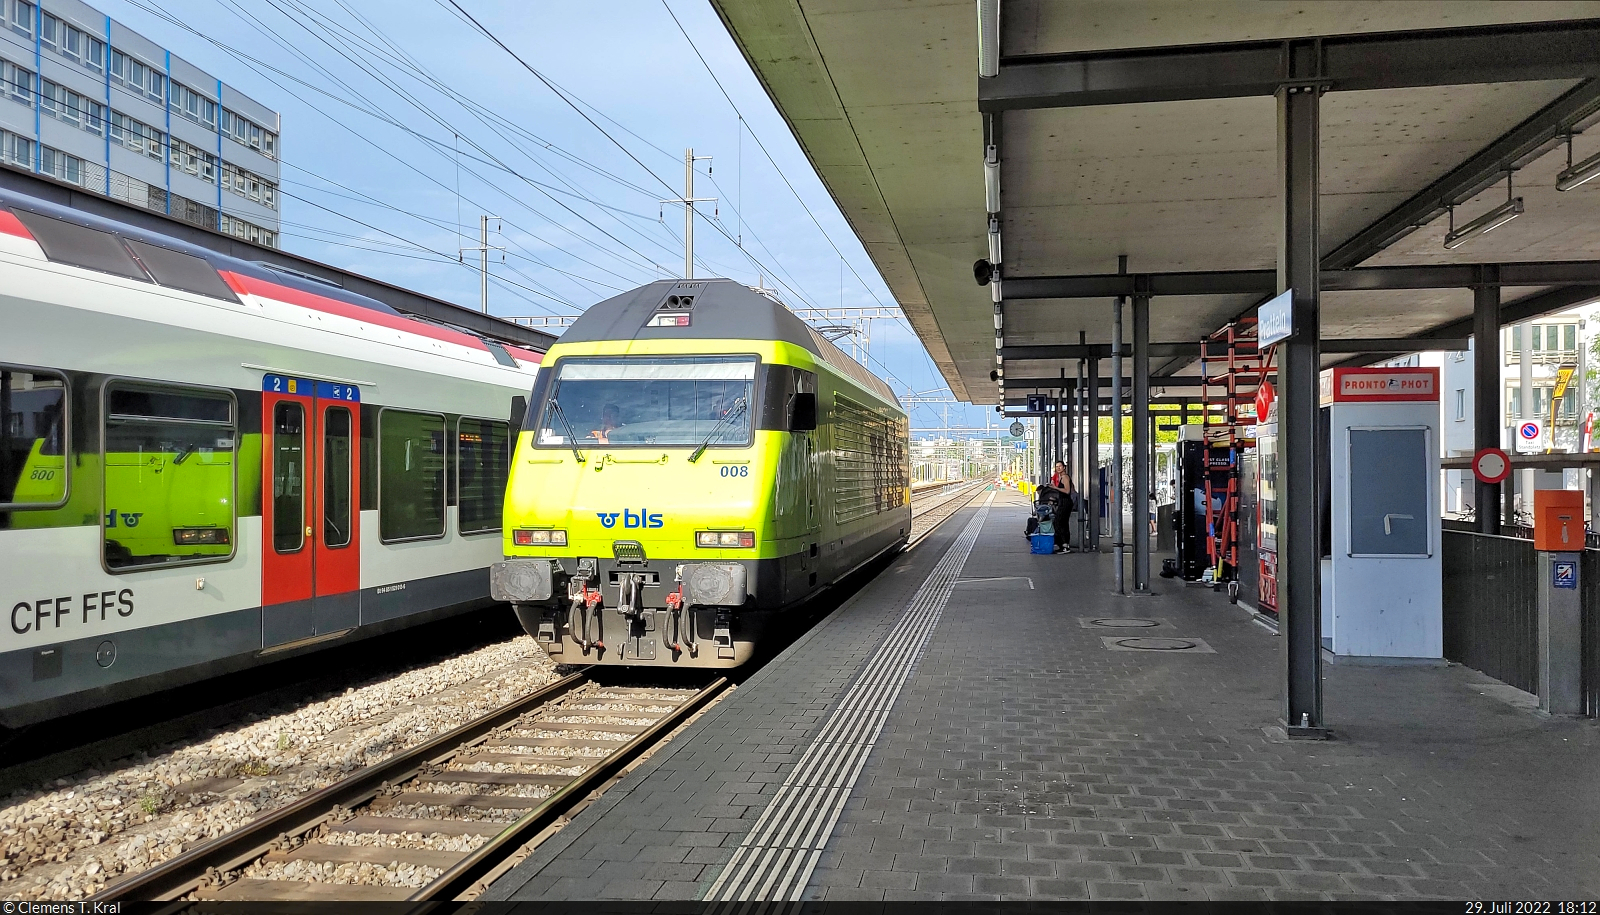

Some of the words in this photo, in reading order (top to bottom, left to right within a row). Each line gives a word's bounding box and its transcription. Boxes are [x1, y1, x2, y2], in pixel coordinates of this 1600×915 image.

[1260, 309, 1286, 340] Pratteln
[273, 377, 281, 392] 2
[1344, 380, 1386, 390] PRONTO
[1401, 380, 1429, 389] PHOT
[346, 387, 353, 401] 2
[1034, 400, 1039, 410] 1
[720, 465, 749, 478] 008
[624, 508, 664, 529] bls
[10, 595, 72, 635] CFF
[82, 588, 135, 624] FFS
